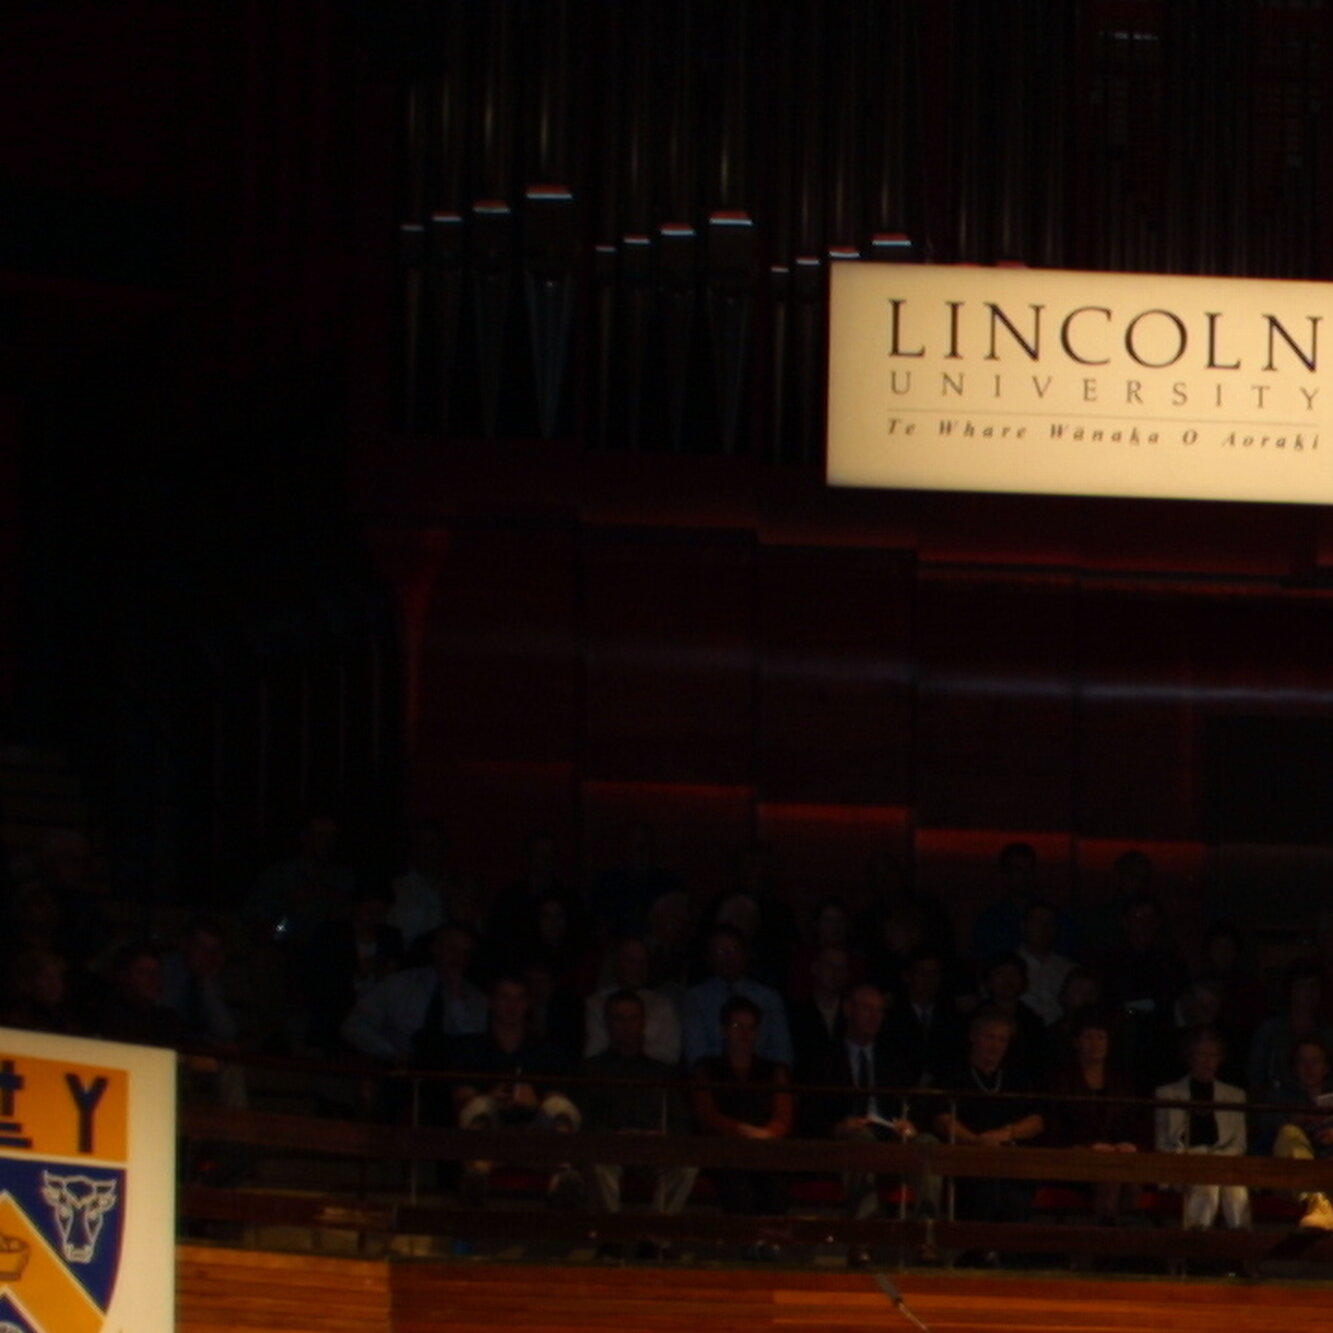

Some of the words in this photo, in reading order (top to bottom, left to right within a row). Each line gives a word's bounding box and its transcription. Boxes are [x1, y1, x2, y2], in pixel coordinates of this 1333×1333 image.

[887, 298, 1323, 373] LINCOLN
[889, 370, 1319, 411] UNIVERSITY
[888, 418, 917, 436] Te
[938, 419, 1028, 439] Whare
[1181, 428, 1199, 446] O
